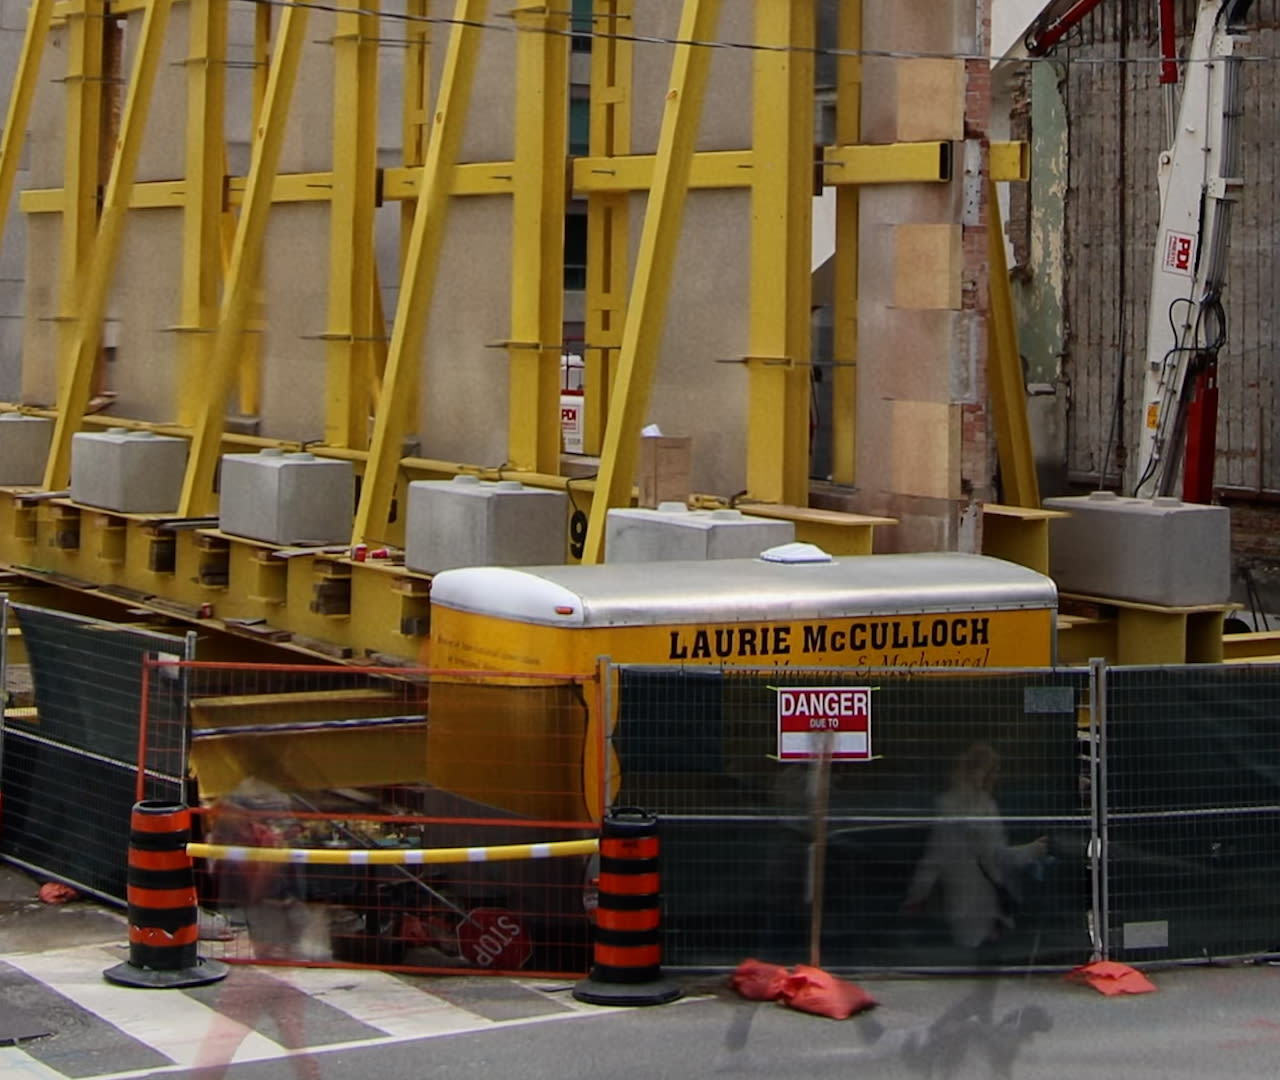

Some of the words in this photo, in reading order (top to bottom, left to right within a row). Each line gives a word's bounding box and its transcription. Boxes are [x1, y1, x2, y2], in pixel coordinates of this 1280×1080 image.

[1176, 238, 1192, 270] PDI
[562, 409, 577, 420] PDI
[670, 626, 791, 660] LAURIE
[803, 617, 990, 654] McCULLOCH
[781, 692, 868, 717] DANGER
[810, 718, 827, 728] DUE
[827, 718, 839, 728] TO
[473, 915, 520, 966] STOP
